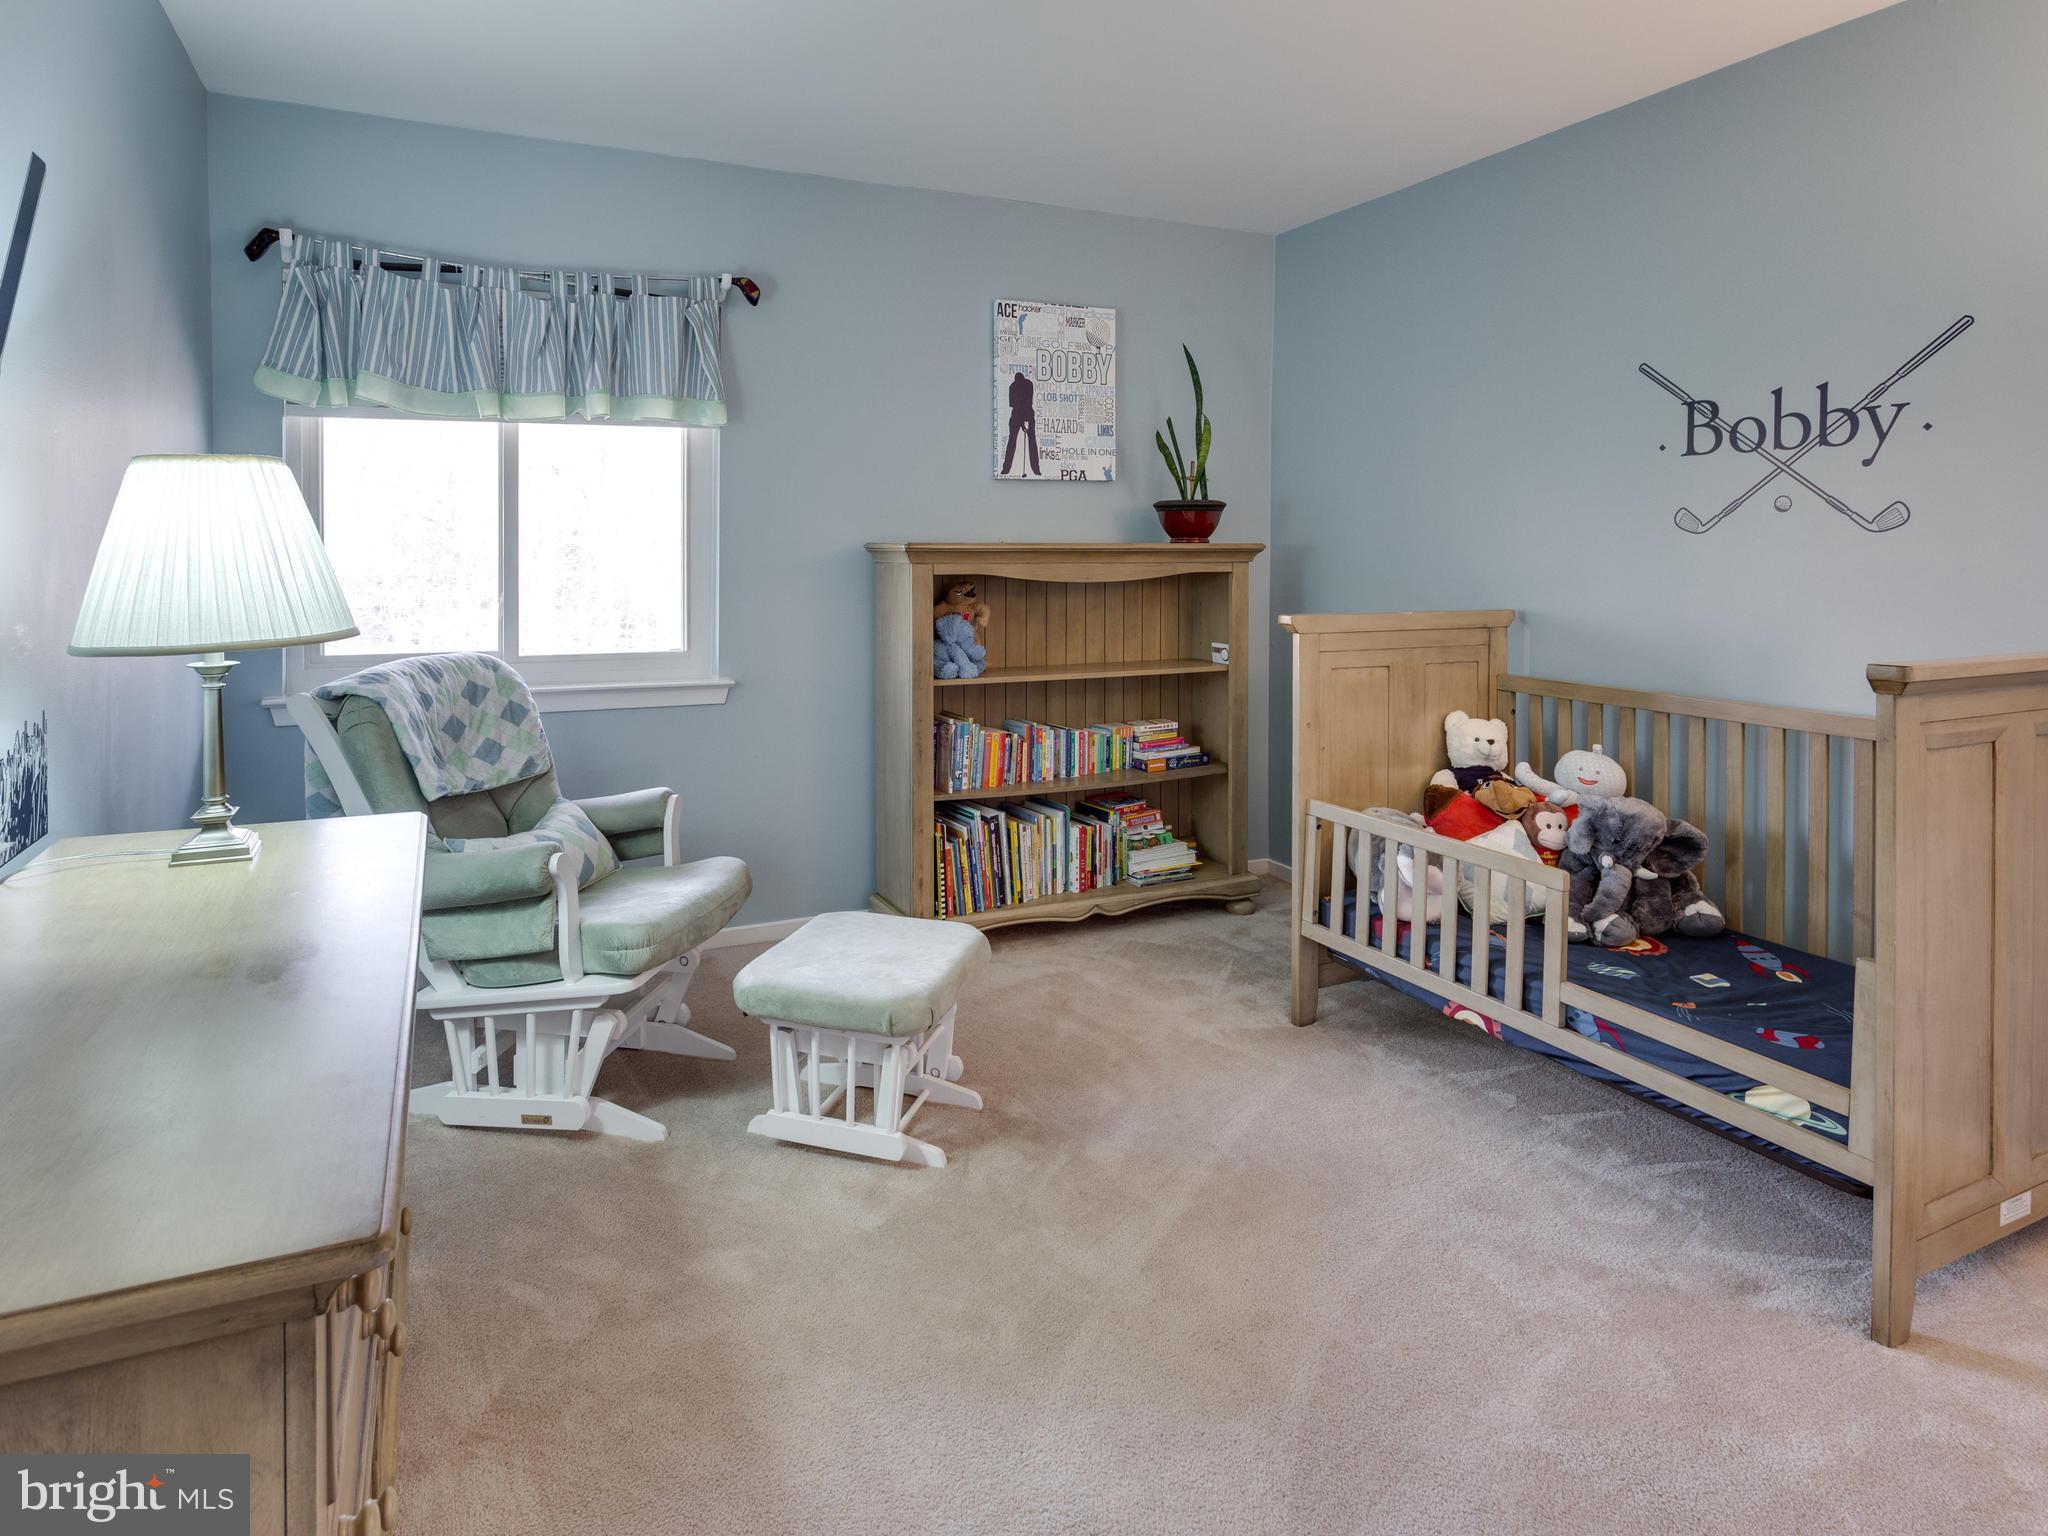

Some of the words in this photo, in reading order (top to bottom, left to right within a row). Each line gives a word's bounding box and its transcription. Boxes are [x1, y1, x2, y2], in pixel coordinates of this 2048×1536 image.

[997, 302, 1018, 318] ACE
[1042, 339, 1073, 349] GOLF
[1036, 348, 1112, 386] BOBBY
[1043, 392, 1057, 402] LOB
[1060, 393, 1077, 403] SHOT
[1043, 418, 1078, 434] HAZARD
[1097, 423, 1114, 437] LINKS
[1680, 381, 1911, 467] Bobby
[1061, 447, 1086, 456] HOLE
[1087, 448, 1097, 456] IN
[1098, 449, 1117, 457] ONE
[1060, 469, 1087, 481] PGA
